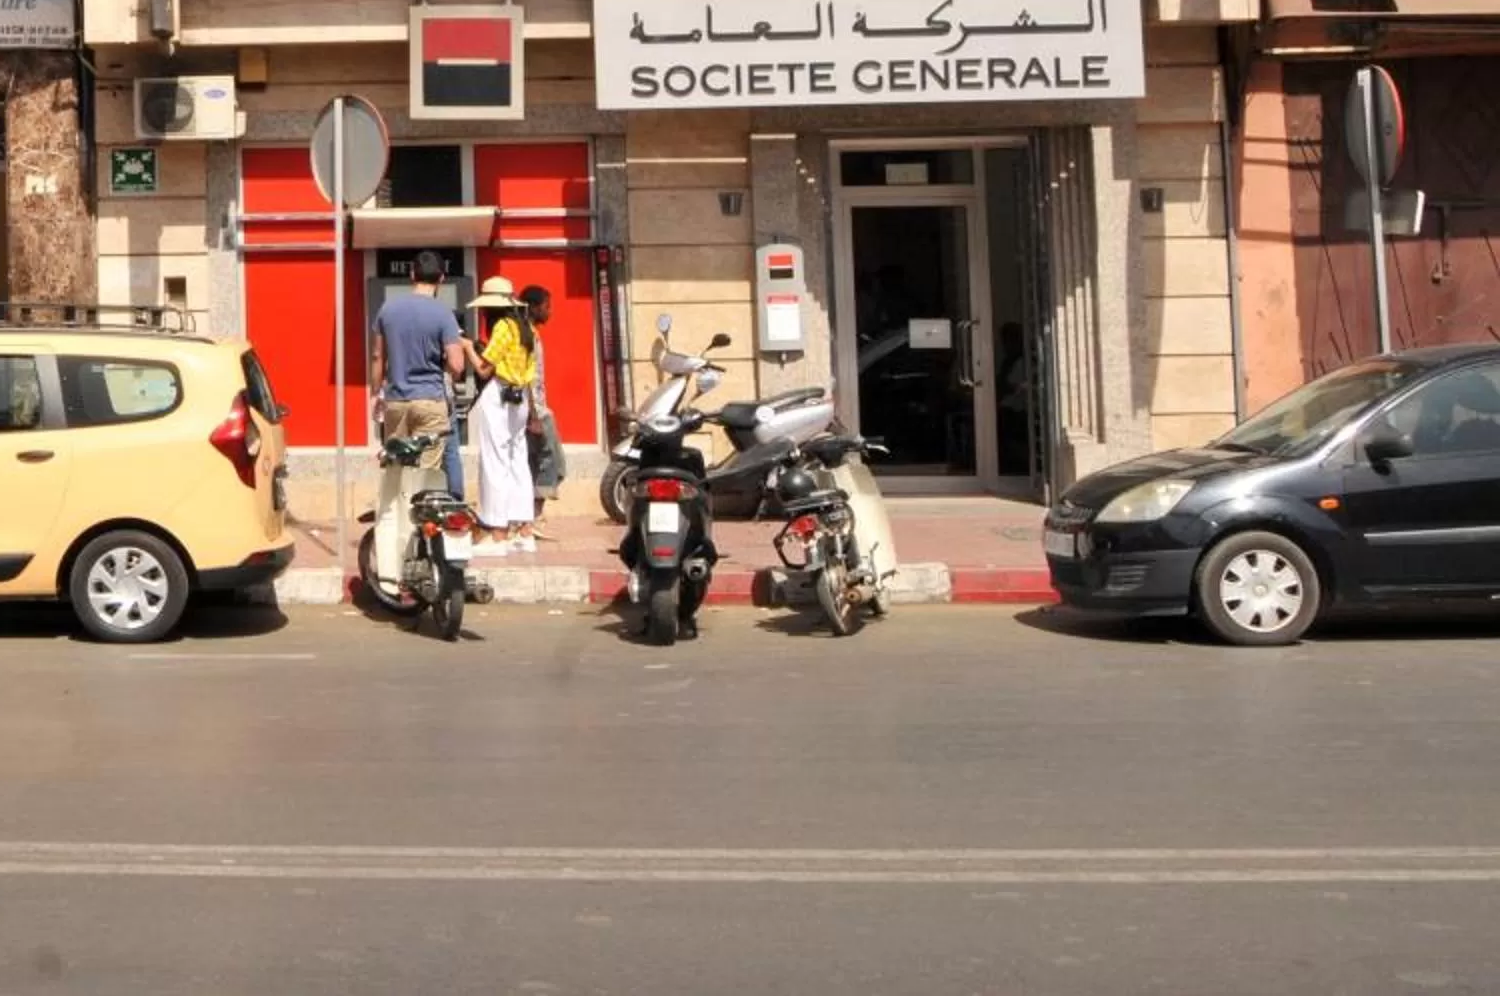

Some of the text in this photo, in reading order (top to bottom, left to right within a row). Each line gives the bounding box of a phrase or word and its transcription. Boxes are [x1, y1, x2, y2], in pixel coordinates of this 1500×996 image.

[630, 0, 835, 44] العامة
[630, 55, 1111, 99] SOCIETE GENERALE
